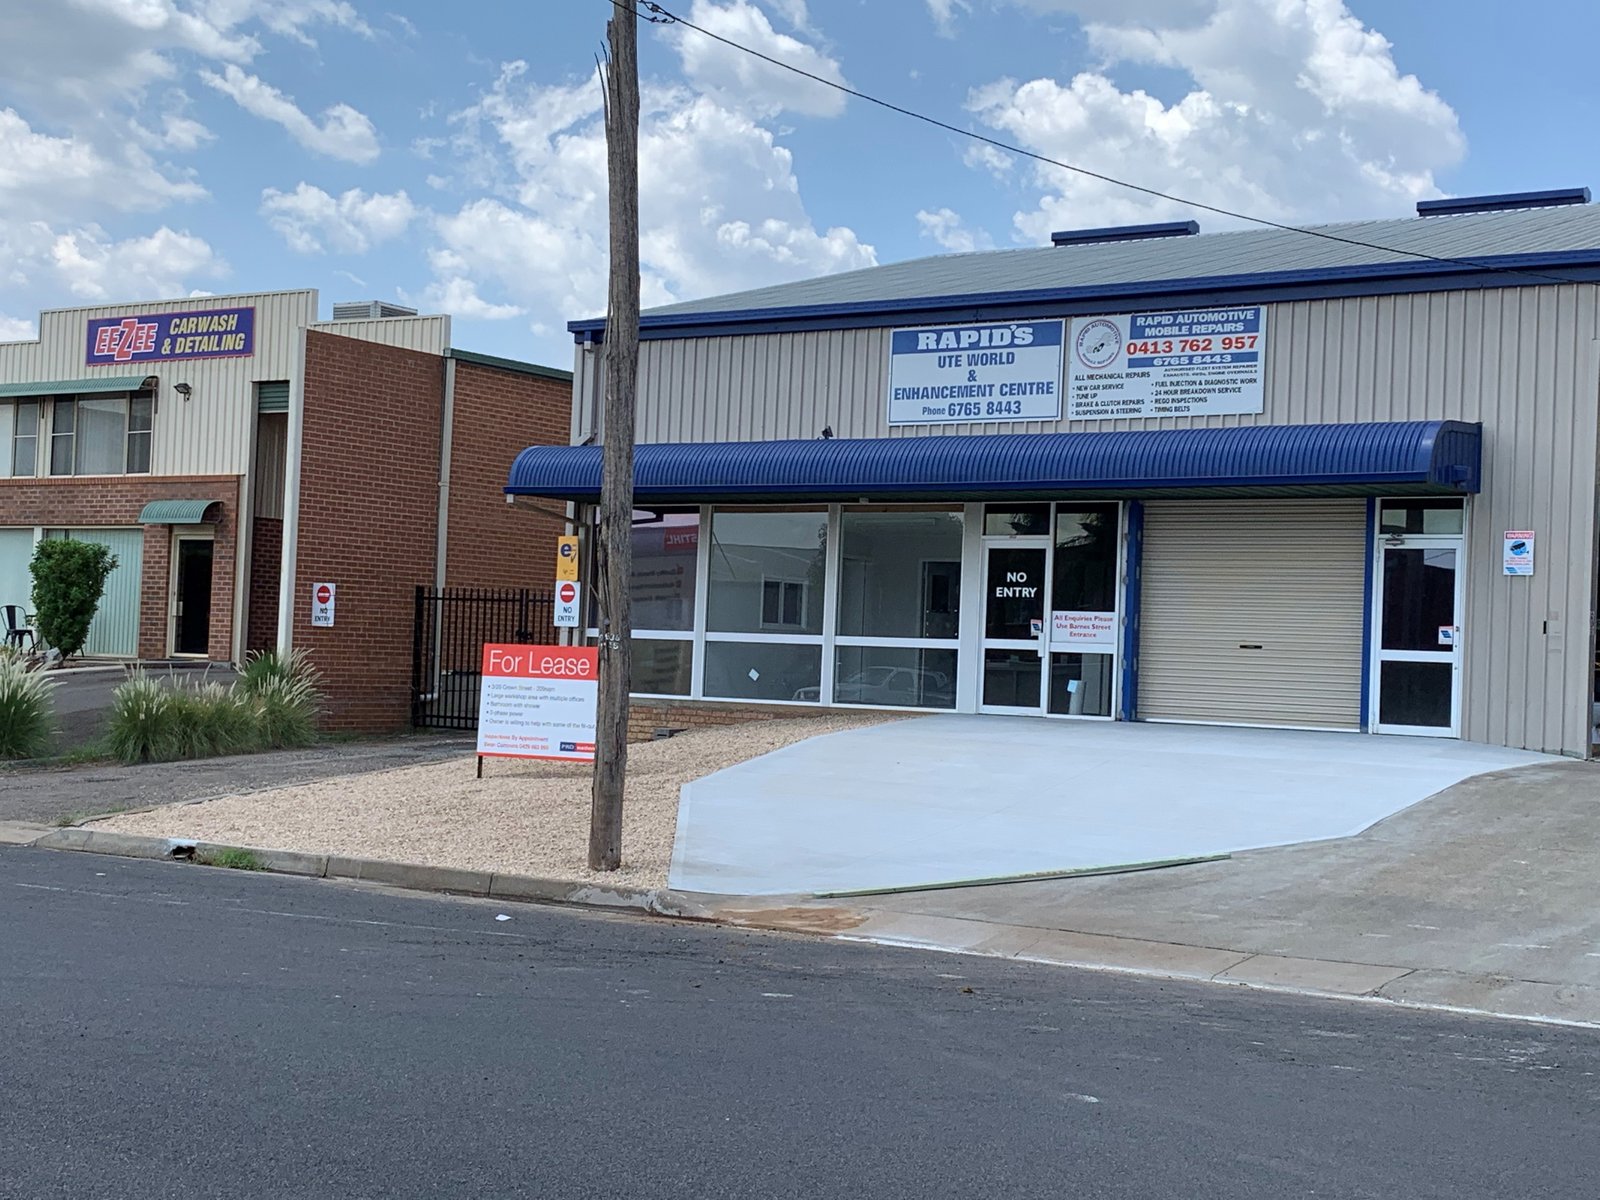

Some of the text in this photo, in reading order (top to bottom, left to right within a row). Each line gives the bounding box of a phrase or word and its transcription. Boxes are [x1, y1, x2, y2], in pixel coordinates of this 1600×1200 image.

[1136, 310, 1255, 326] RAPID AUTOMOTIVE
[169, 314, 239, 335] CARWASH
[1144, 322, 1245, 337] MOBILE REPAIRS
[94, 319, 158, 360] EEZEE
[161, 333, 246, 354] & DETAILING
[917, 325, 1034, 350] RAPID'S
[1126, 335, 1259, 356] 0413 762 957
[938, 352, 1016, 369] UTE WORLD
[1153, 354, 1232, 366] 6765 8443
[967, 369, 977, 382] &
[1087, 373, 1124, 381] MECHANICAL
[1125, 371, 1151, 379] REPAIRS
[1169, 379, 1197, 387] INJECTION
[1204, 378, 1239, 386] DIAGNOSTIC
[1240, 377, 1258, 385] WORK
[894, 381, 1055, 401] ENHANCEMENT CENTRE
[1179, 387, 1217, 395] BREAKDOWN
[1217, 386, 1242, 394] SERVICE
[1122, 398, 1145, 406] REPAIRS
[1154, 396, 1208, 405] REGO INSPECTIONS
[922, 401, 1022, 418] Phone 6765 8443
[1075, 408, 1109, 416] SUSPENSION
[1174, 405, 1191, 413] BELTS
[1006, 571, 1028, 583] NO
[995, 586, 1038, 599] ENTRY
[319, 607, 328, 615] NO
[563, 606, 573, 614] NO
[557, 615, 576, 623] ENTRY
[1064, 615, 1093, 623] Enquiries
[489, 650, 590, 676] For Lease
